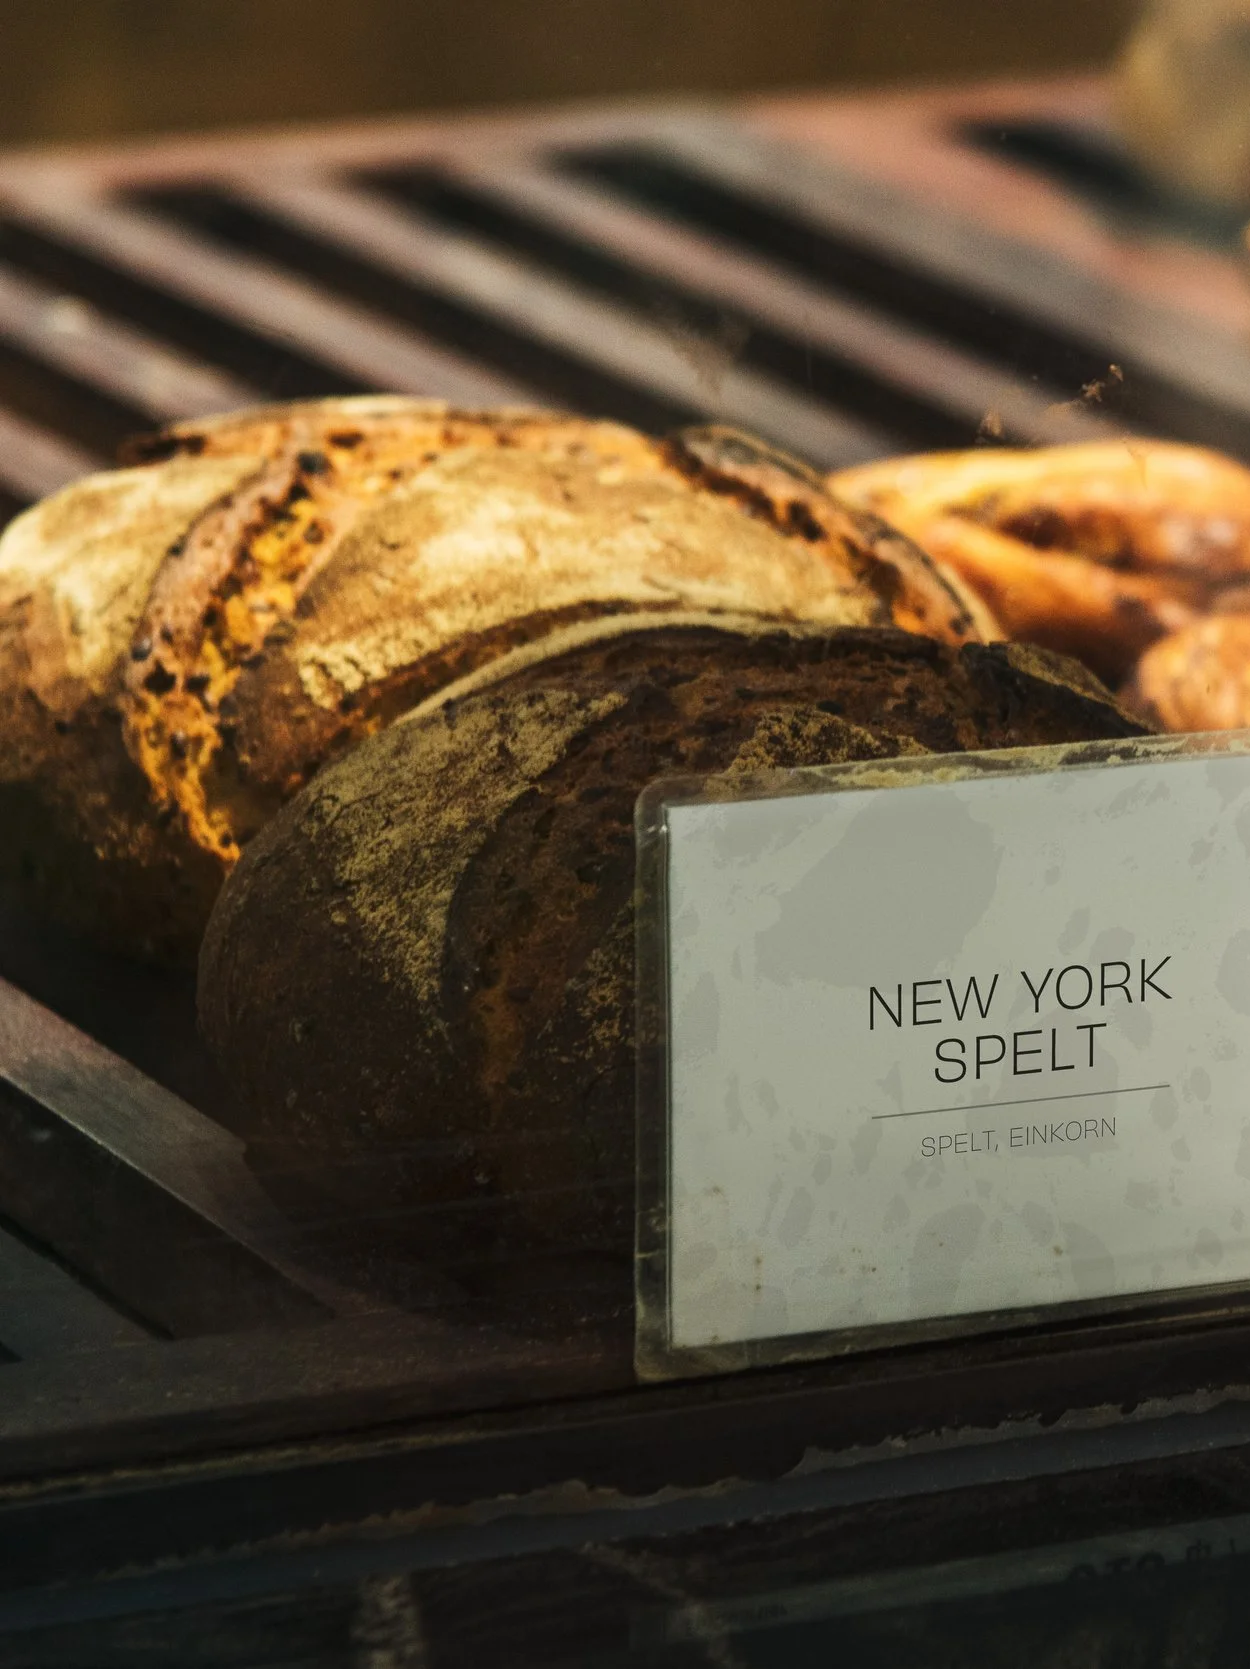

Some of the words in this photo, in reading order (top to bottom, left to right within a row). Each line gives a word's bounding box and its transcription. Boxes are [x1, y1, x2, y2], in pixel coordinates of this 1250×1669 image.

[869, 973, 1000, 1031] NEW
[1019, 955, 1173, 1014] YORK
[934, 1022, 1108, 1084] SPELT
[921, 1129, 999, 1158] SPELT,
[1009, 1116, 1117, 1148] EINKORN
